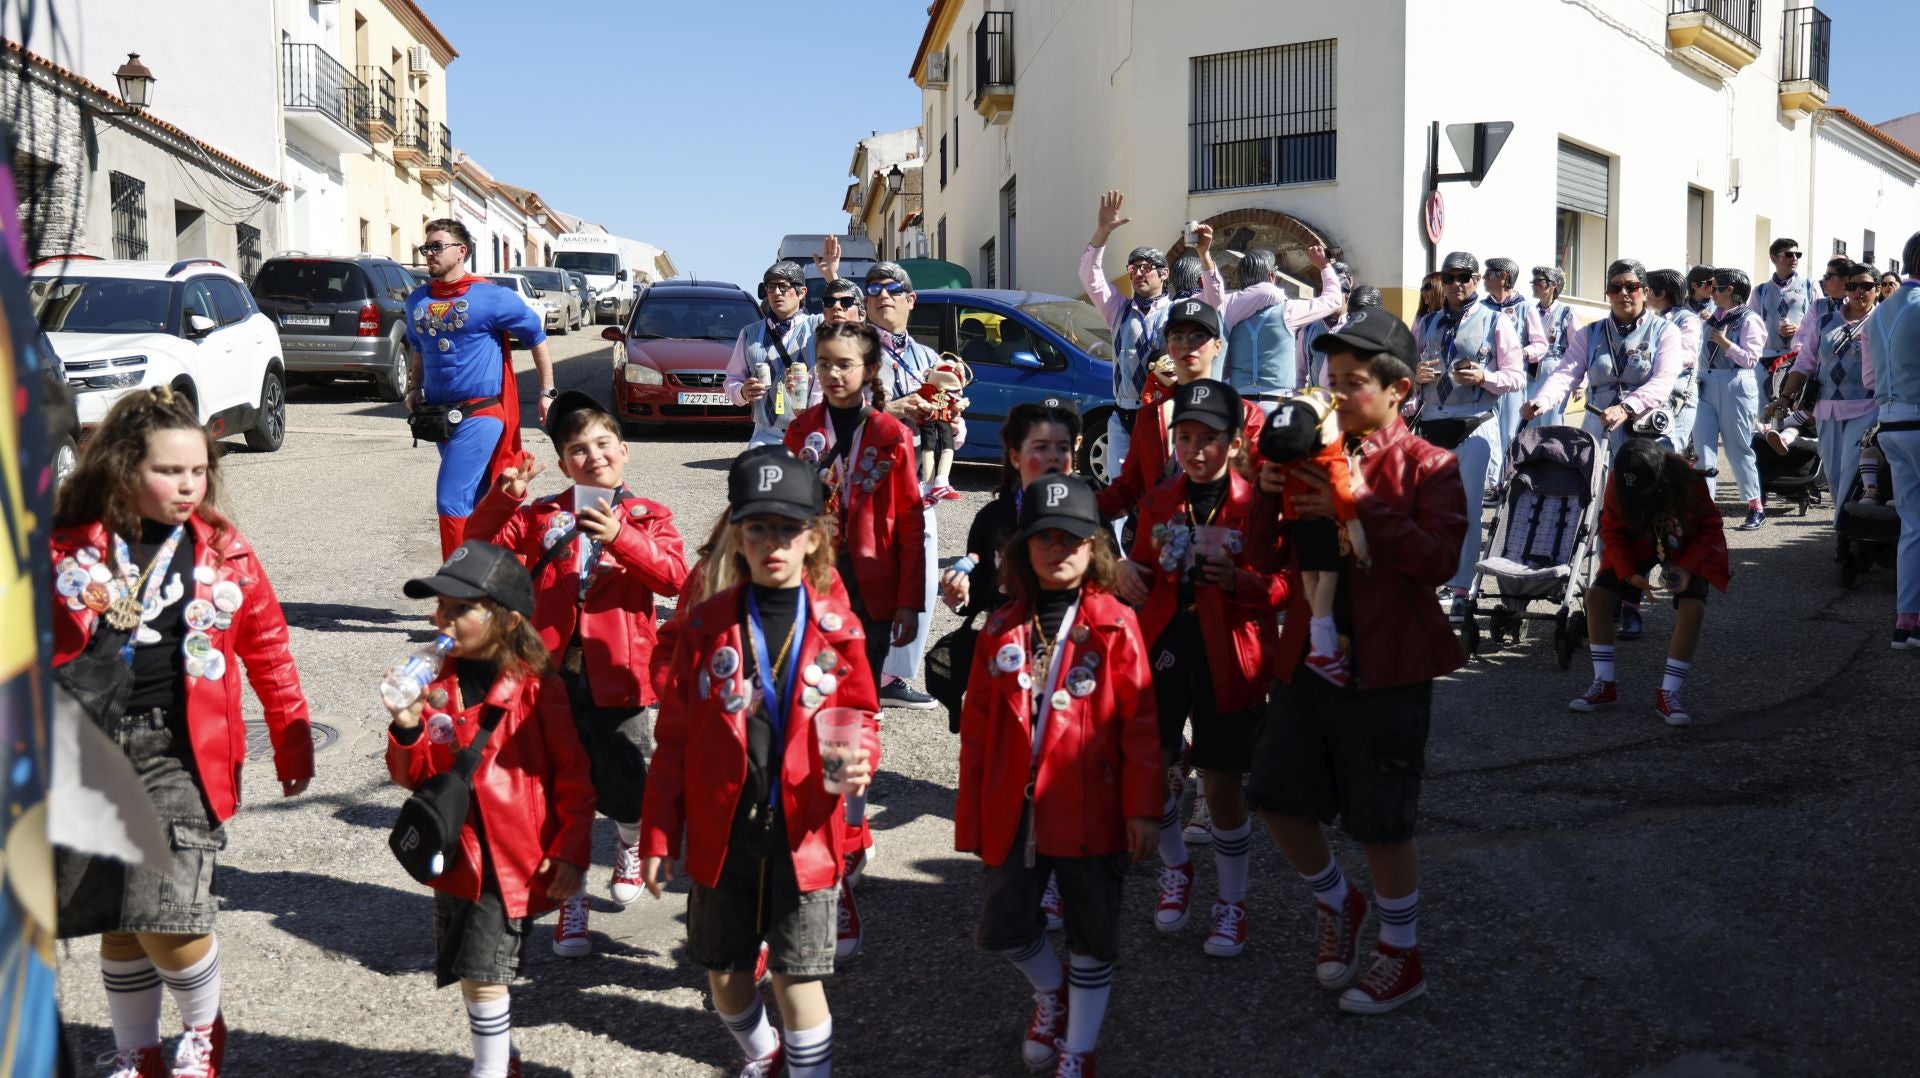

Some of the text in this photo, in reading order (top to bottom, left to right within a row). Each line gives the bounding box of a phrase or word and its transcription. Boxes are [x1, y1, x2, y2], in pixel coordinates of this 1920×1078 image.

[563, 236, 608, 244] MADEREX
[1185, 302, 1201, 315] P
[684, 394, 708, 404] 7272
[1191, 386, 1210, 404] P
[1273, 405, 1294, 428] P
[758, 465, 783, 491] P
[1046, 483, 1068, 507] P
[444, 547, 468, 567] P
[1155, 650, 1175, 670] P
[401, 825, 420, 851] P
